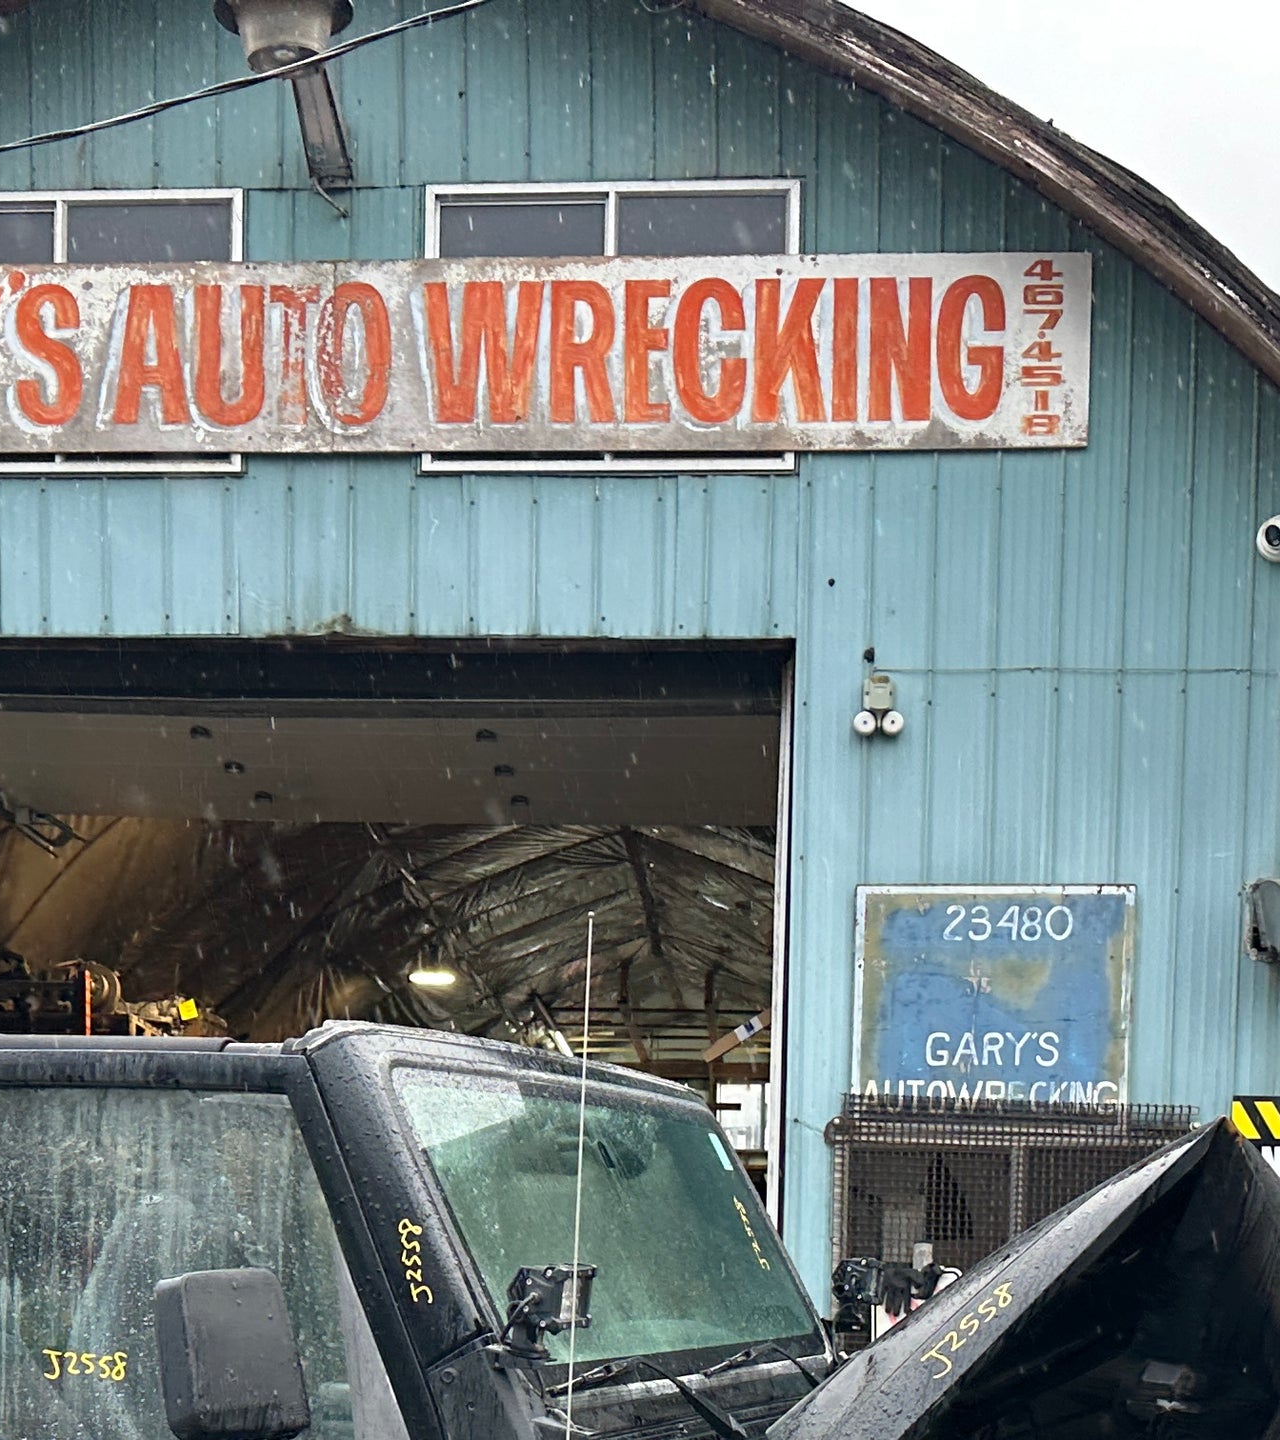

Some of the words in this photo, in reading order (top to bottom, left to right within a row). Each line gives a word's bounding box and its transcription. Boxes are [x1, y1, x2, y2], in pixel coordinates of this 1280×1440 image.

[120, 281, 392, 427] AUTO
[423, 274, 1006, 424] WRECKING
[942, 904, 1074, 942] 23480
[924, 1031, 1061, 1067] GARY'S
[398, 1218, 433, 1304] J2558
[920, 1281, 1013, 1379] J2558
[42, 1349, 128, 1380] J2558
